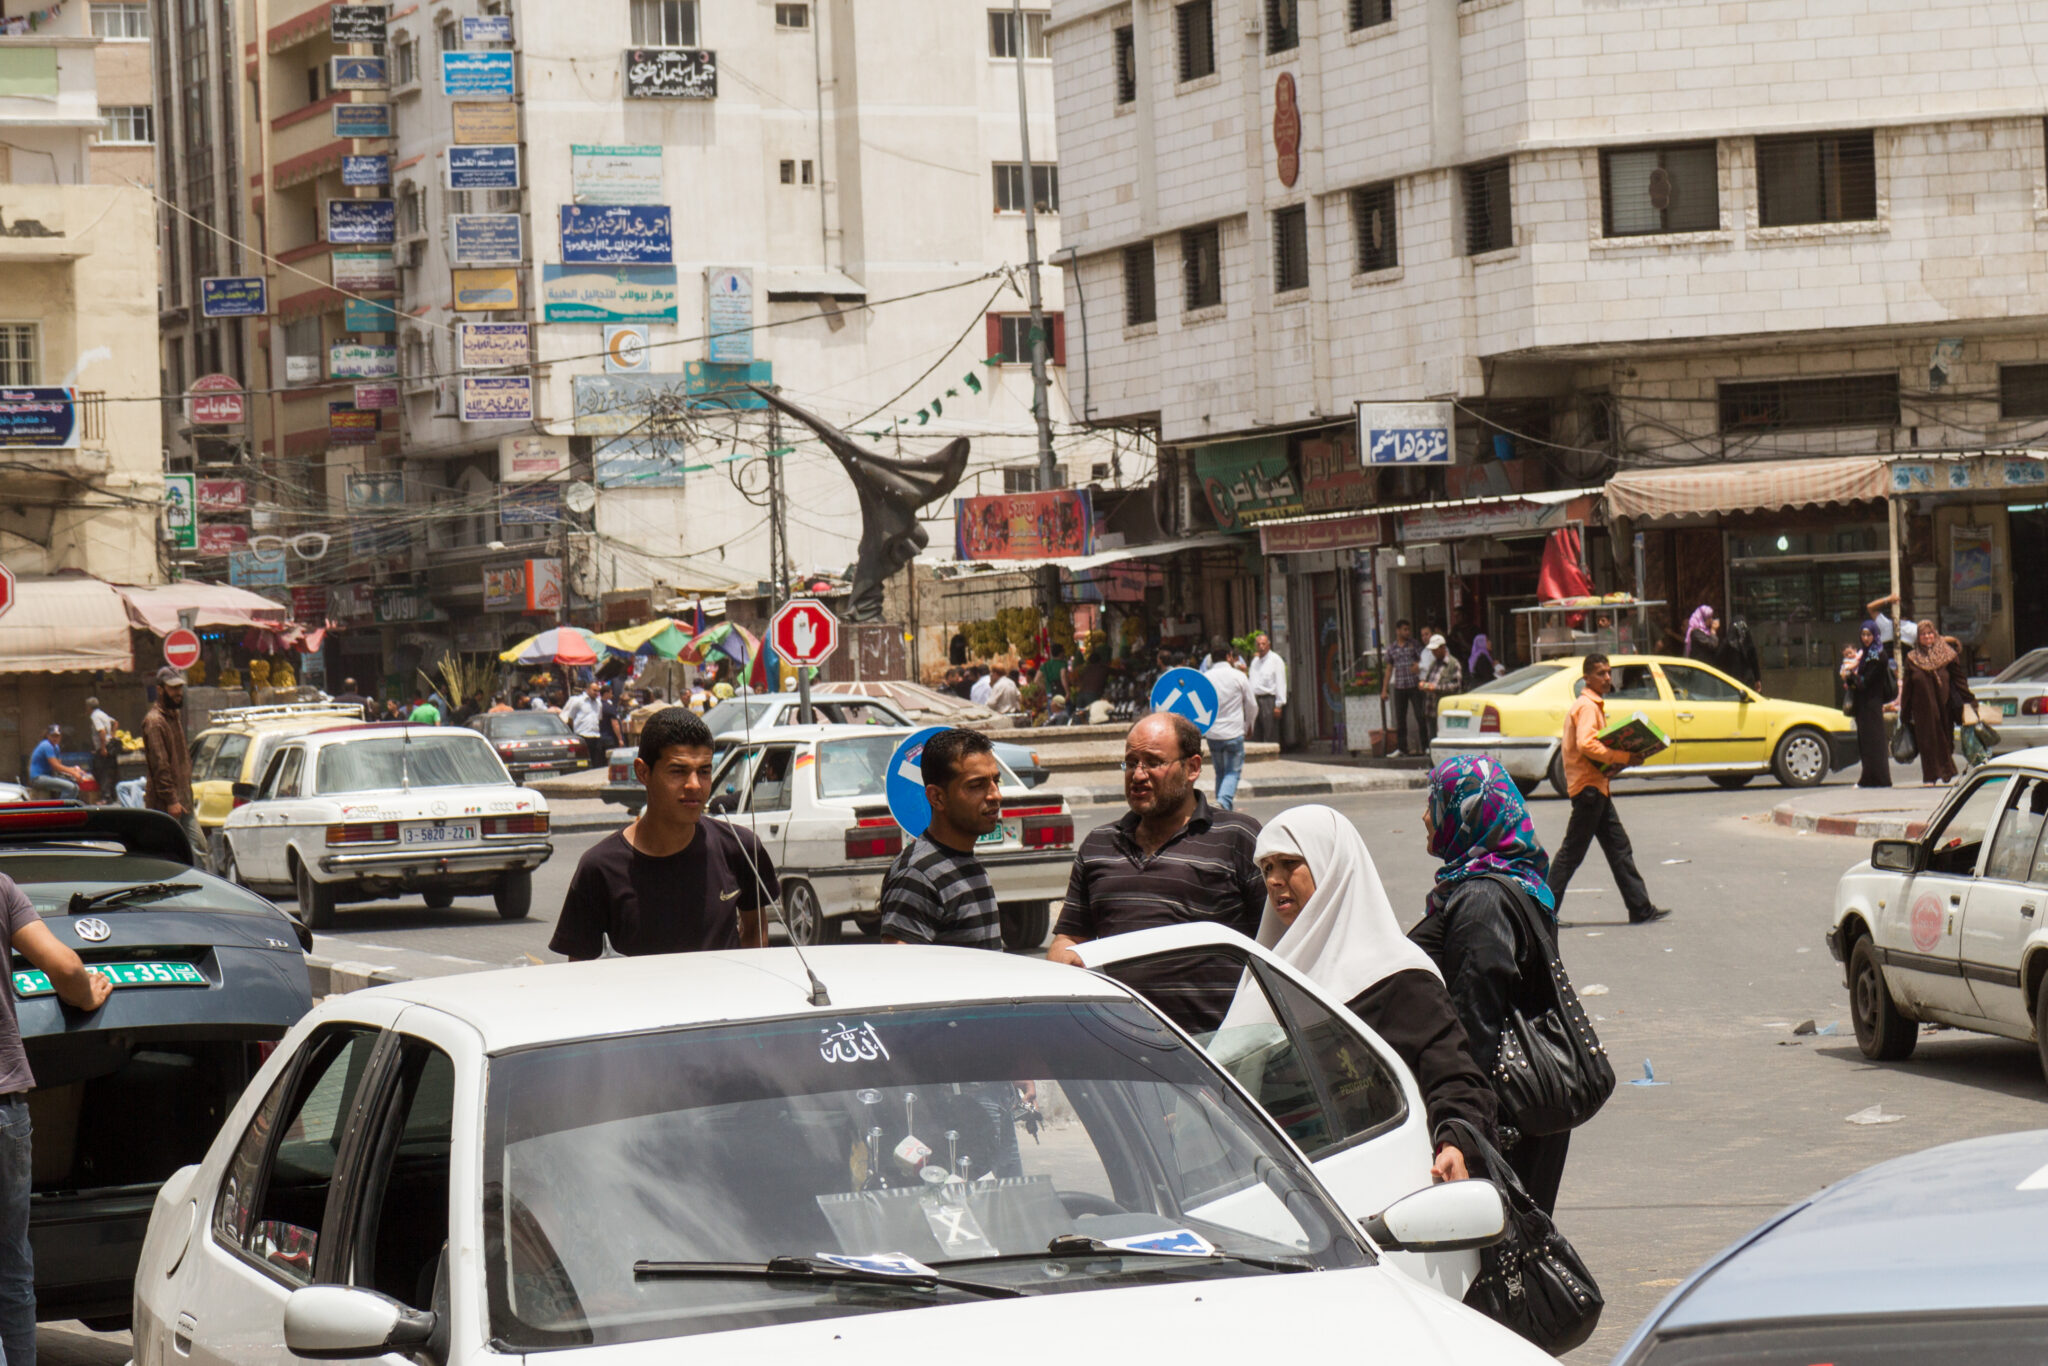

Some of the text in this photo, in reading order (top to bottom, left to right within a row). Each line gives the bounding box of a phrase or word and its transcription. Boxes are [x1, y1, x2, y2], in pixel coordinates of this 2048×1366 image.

[656, 51, 687, 63] دكتور
[684, 61, 716, 87] جميل
[605, 160, 633, 169] دكتور
[605, 207, 631, 217] دكتور
[225, 290, 246, 300] محمد
[548, 288, 675, 303] مركز بيولاب للتحاليل الطبية
[196, 395, 242, 419] حلويات
[1371, 427, 1448, 463] غزة هاشم
[821, 1021, 890, 1064] الله
[931, 1209, 981, 1248] X
